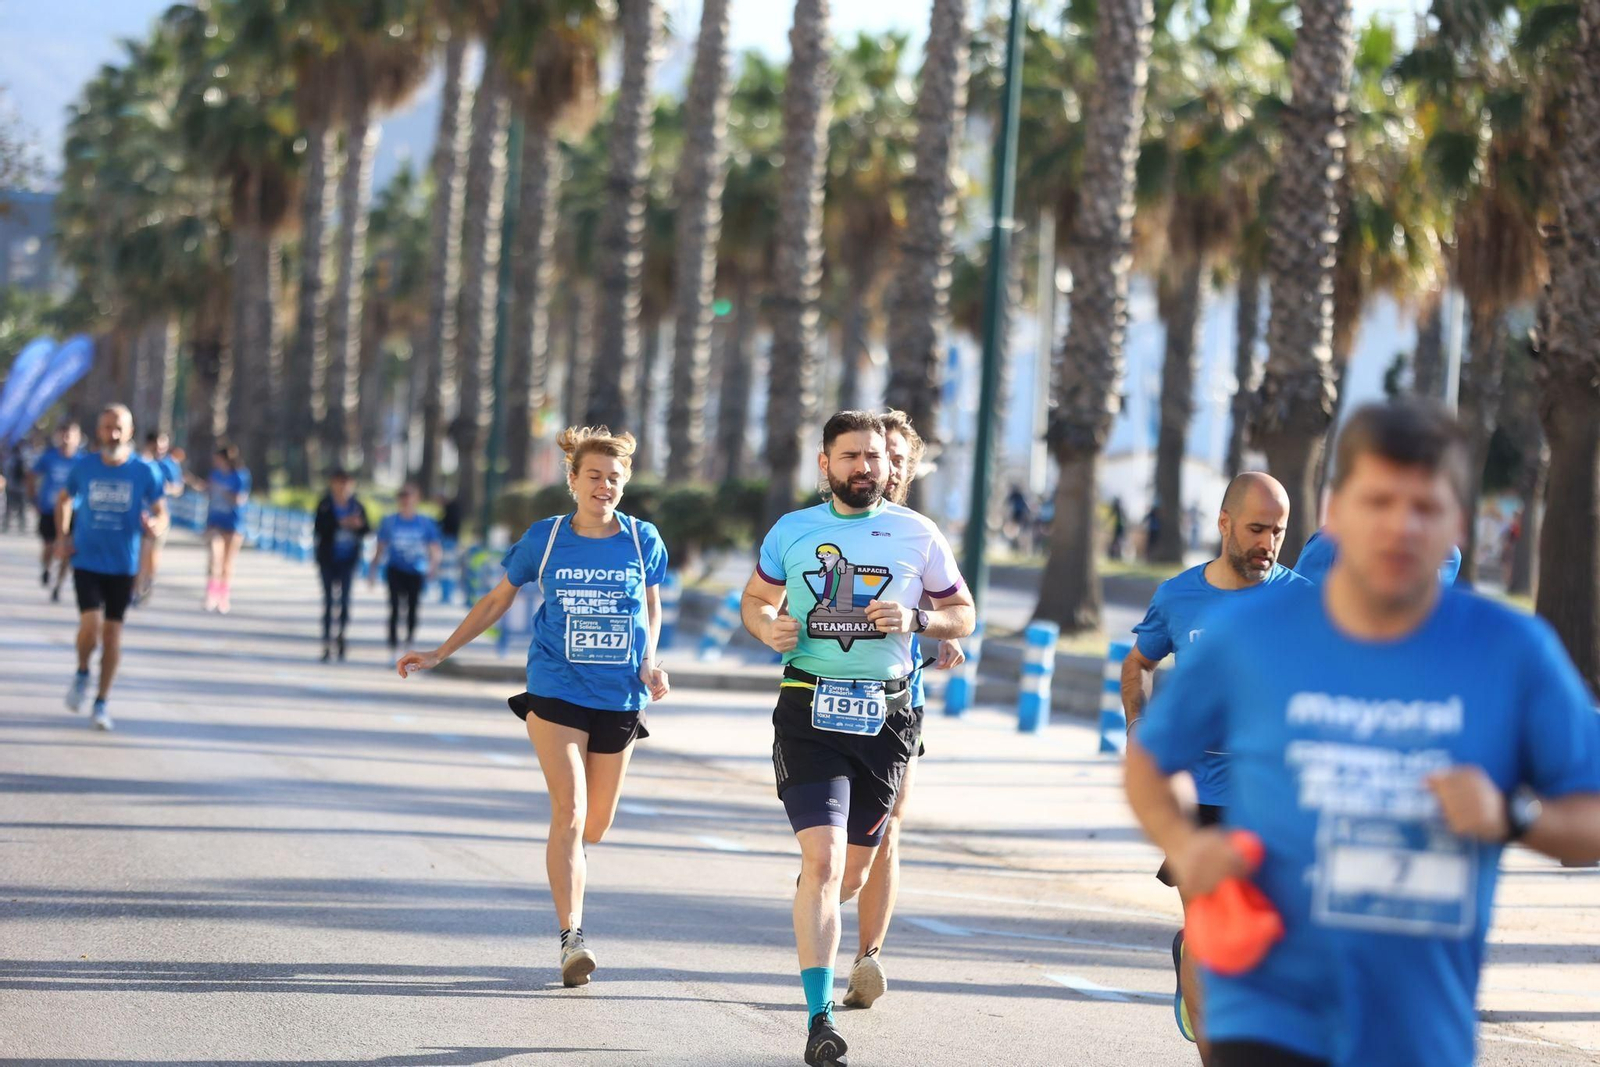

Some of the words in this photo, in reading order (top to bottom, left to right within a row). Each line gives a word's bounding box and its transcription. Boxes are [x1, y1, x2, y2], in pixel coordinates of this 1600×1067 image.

[555, 568, 630, 583] mayoral
[563, 598, 618, 607] MAKES
[563, 605, 619, 614] FRIENDS
[811, 622, 878, 632] #TEAMRAPA
[575, 633, 624, 647] 2147
[823, 697, 879, 716] 1910
